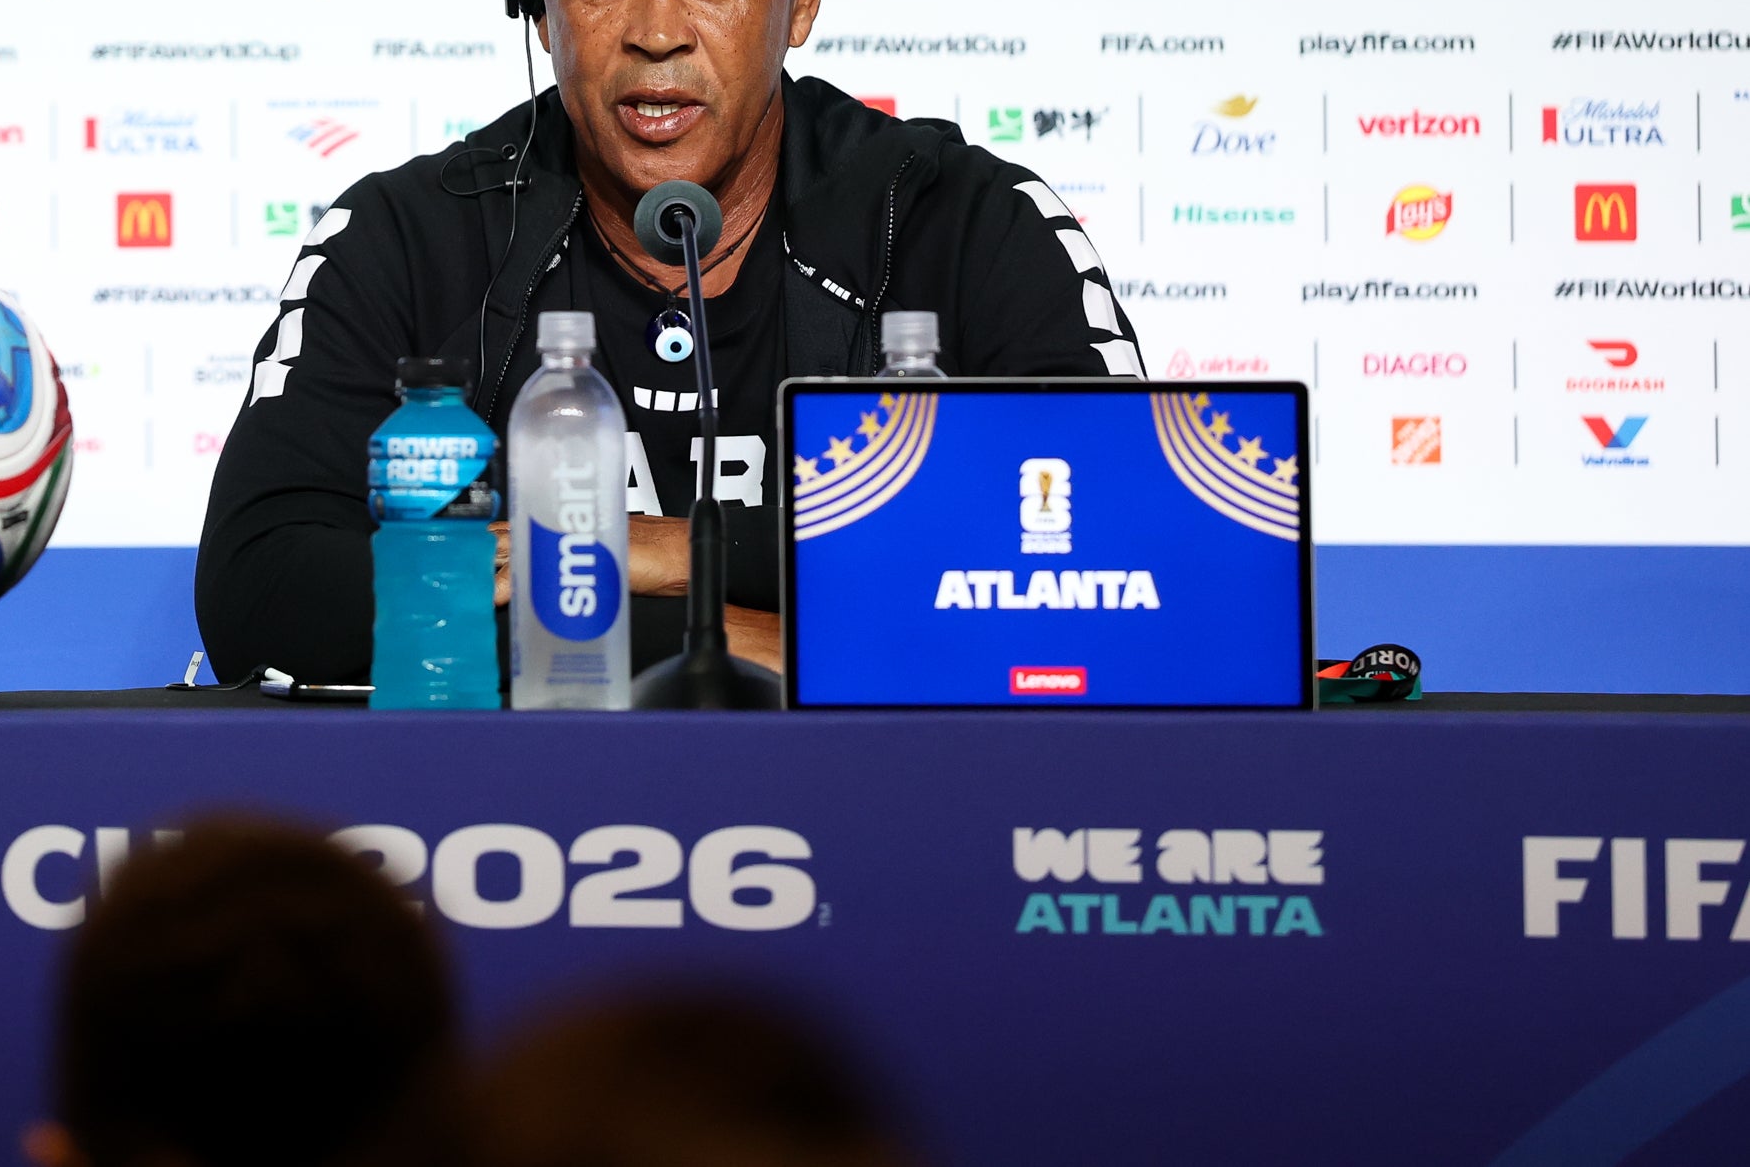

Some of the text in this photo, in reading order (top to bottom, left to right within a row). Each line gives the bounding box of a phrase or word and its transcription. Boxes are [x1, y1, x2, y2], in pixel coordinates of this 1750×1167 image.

[373, 40, 495, 58] FIFA.com
[815, 36, 1026, 57] #FIFAWorldCup
[1101, 35, 1224, 52] FIFA.com
[1300, 34, 1475, 55] play.fifa.com
[1359, 110, 1480, 135] verizon
[1192, 123, 1276, 155] Dove
[1565, 127, 1662, 144] ULTRA
[1173, 205, 1295, 223] Hisense
[1303, 281, 1477, 302] play.fifa.com
[1200, 357, 1269, 374] airbnb
[1363, 354, 1467, 376] DIAGEO
[1566, 378, 1665, 391] DOORDASH
[387, 437, 478, 458] POWER
[552, 460, 597, 618] smart
[934, 570, 1161, 610] ATLANTA
[1016, 672, 1081, 690] Lenovo
[1013, 827, 1141, 883] WE
[1015, 894, 1324, 937] ATLANTA
